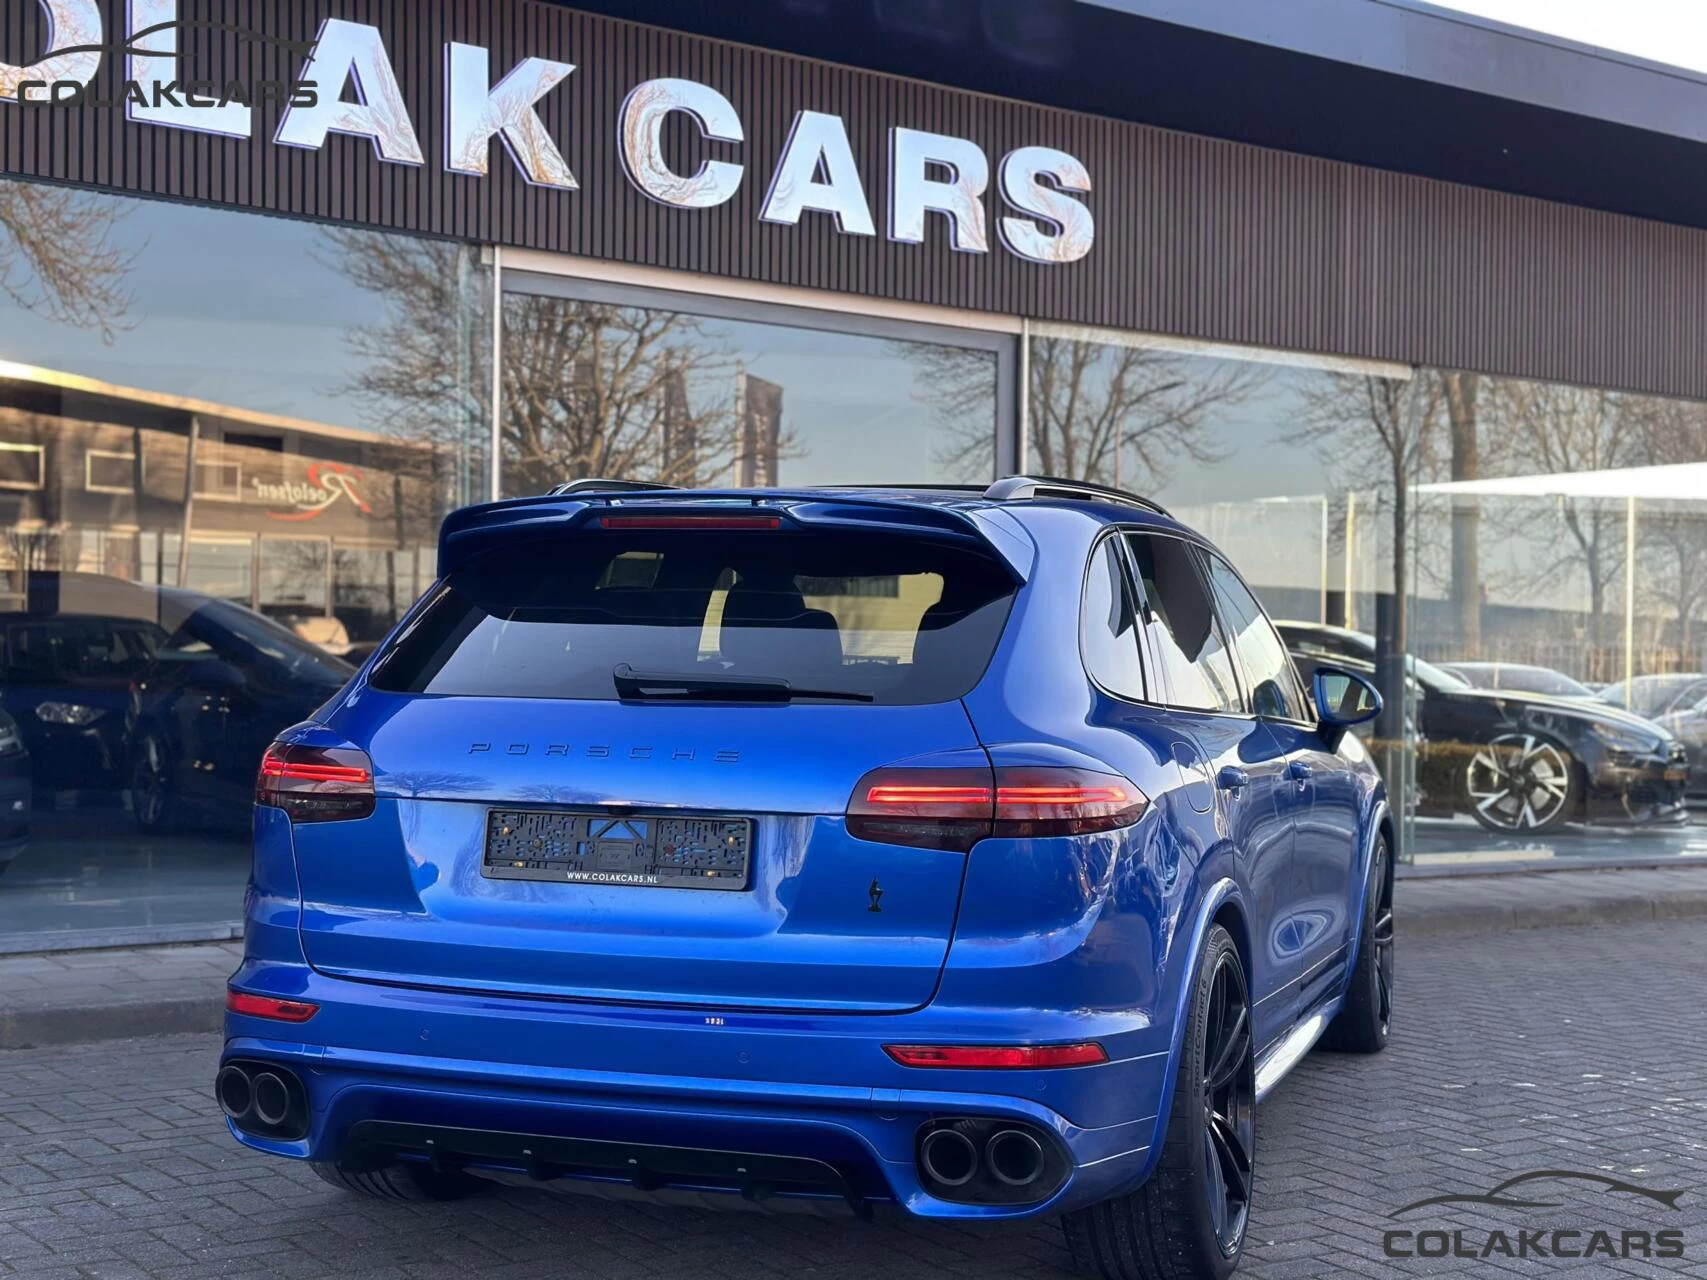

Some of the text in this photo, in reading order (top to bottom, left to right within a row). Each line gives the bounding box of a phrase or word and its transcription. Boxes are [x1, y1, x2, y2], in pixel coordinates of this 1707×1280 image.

[617, 77, 1095, 264] CARS
[468, 742, 741, 763] PORSCHE
[566, 871, 658, 884] WWW.COLAKCARS.NL
